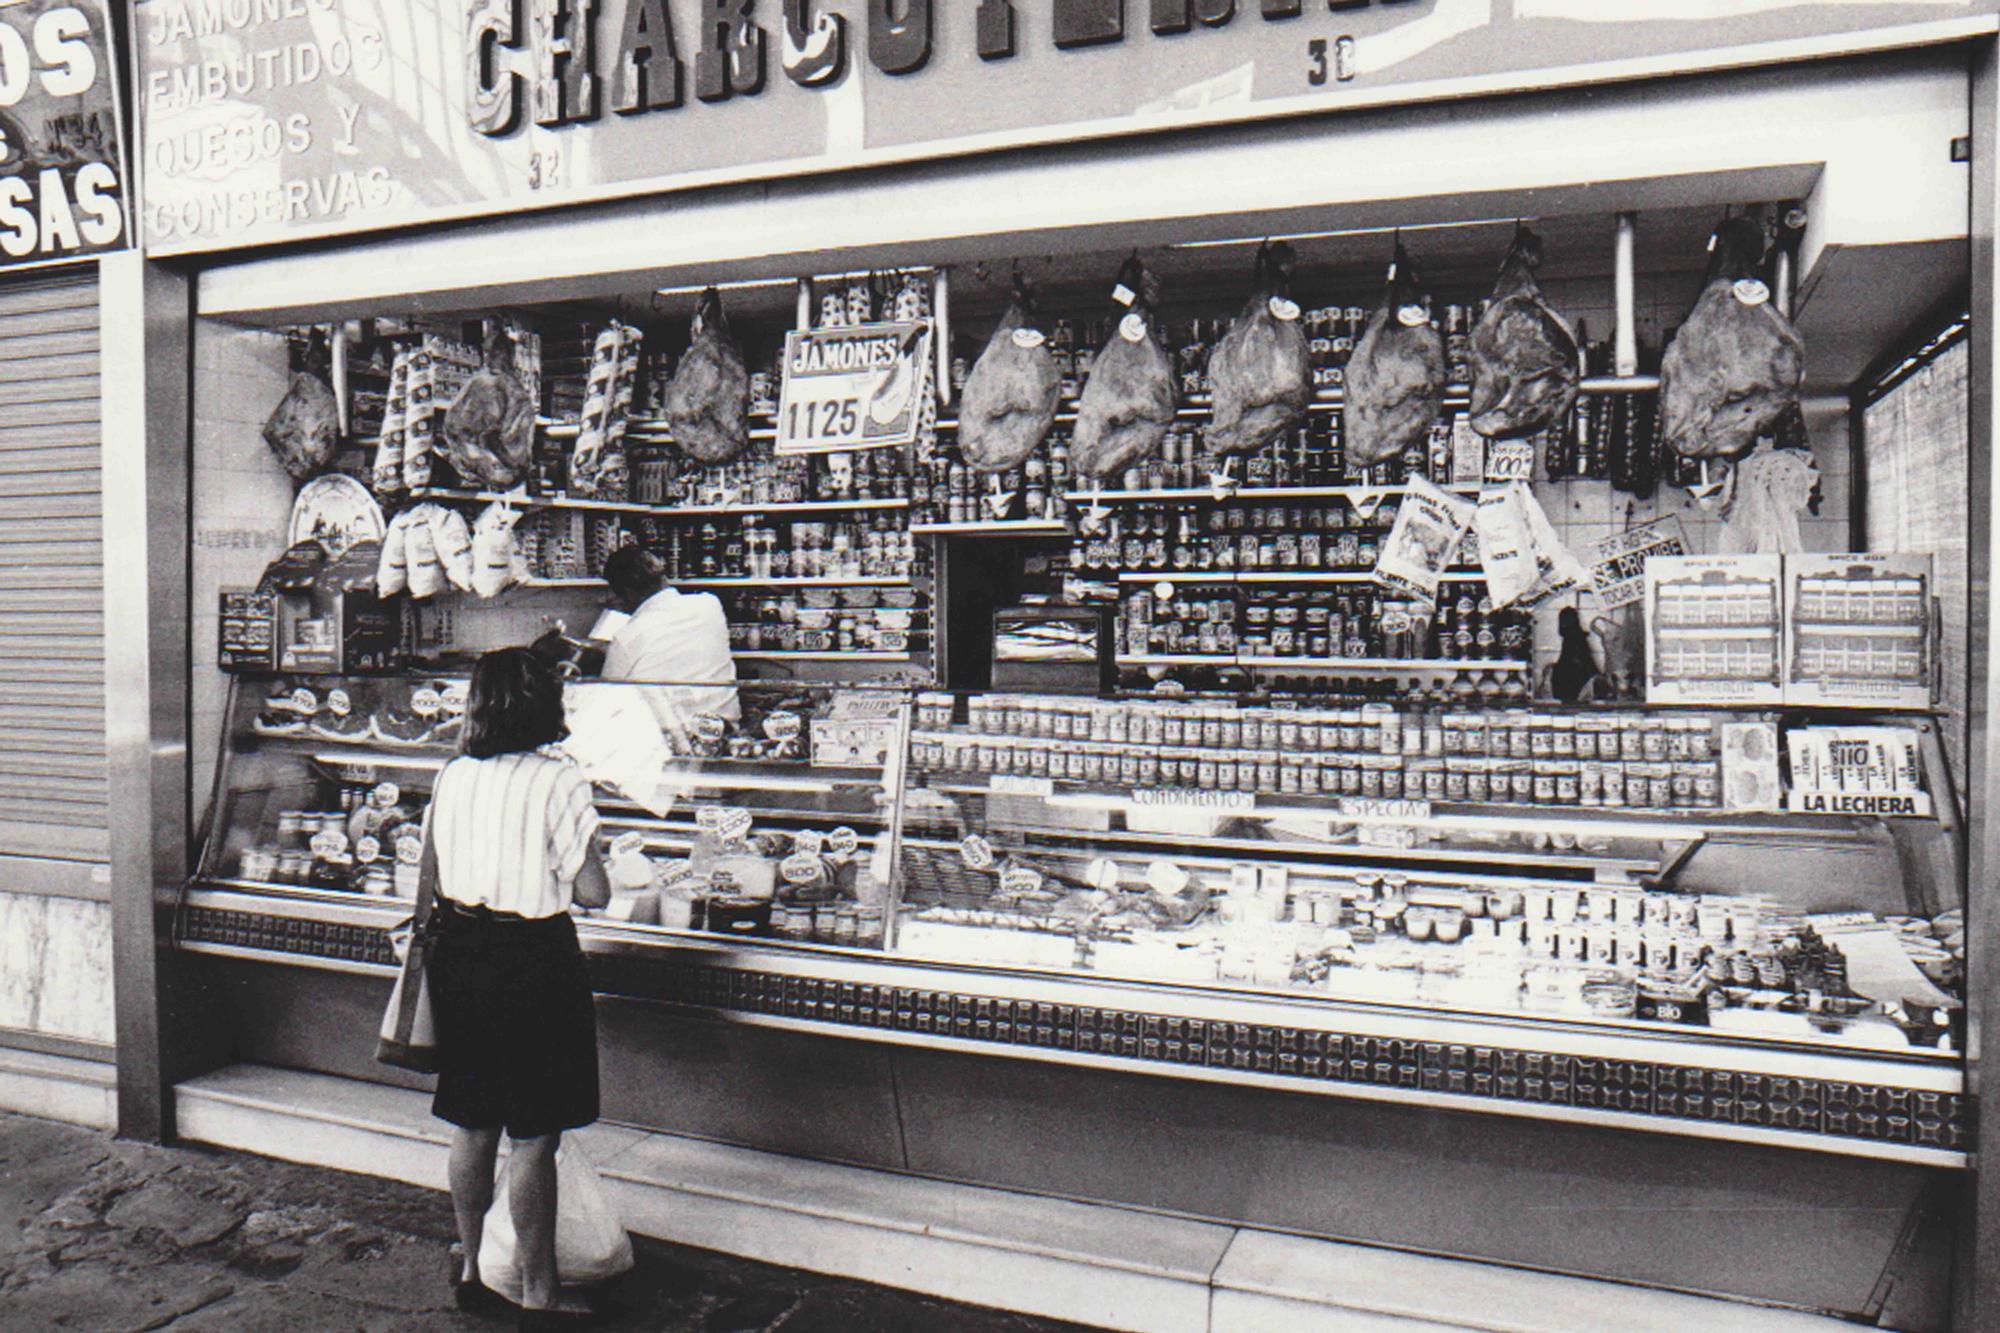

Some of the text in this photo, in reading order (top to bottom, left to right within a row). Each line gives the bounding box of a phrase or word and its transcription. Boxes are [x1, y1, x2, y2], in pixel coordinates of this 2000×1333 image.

[148, 30, 384, 109] EMBUTIDOS
[466, 0, 1420, 137] CHARCU
[154, 103, 363, 177] QUESOS Y
[151, 166, 393, 238] CONSERVAS
[792, 337, 898, 374] JAMONES
[788, 398, 859, 440] 1125
[1841, 747, 1868, 766] 110
[1132, 788, 1252, 808] CONDIMENTOS
[1340, 799, 1428, 817] ESPECIAS
[1803, 795, 1916, 814] LA LECHERA
